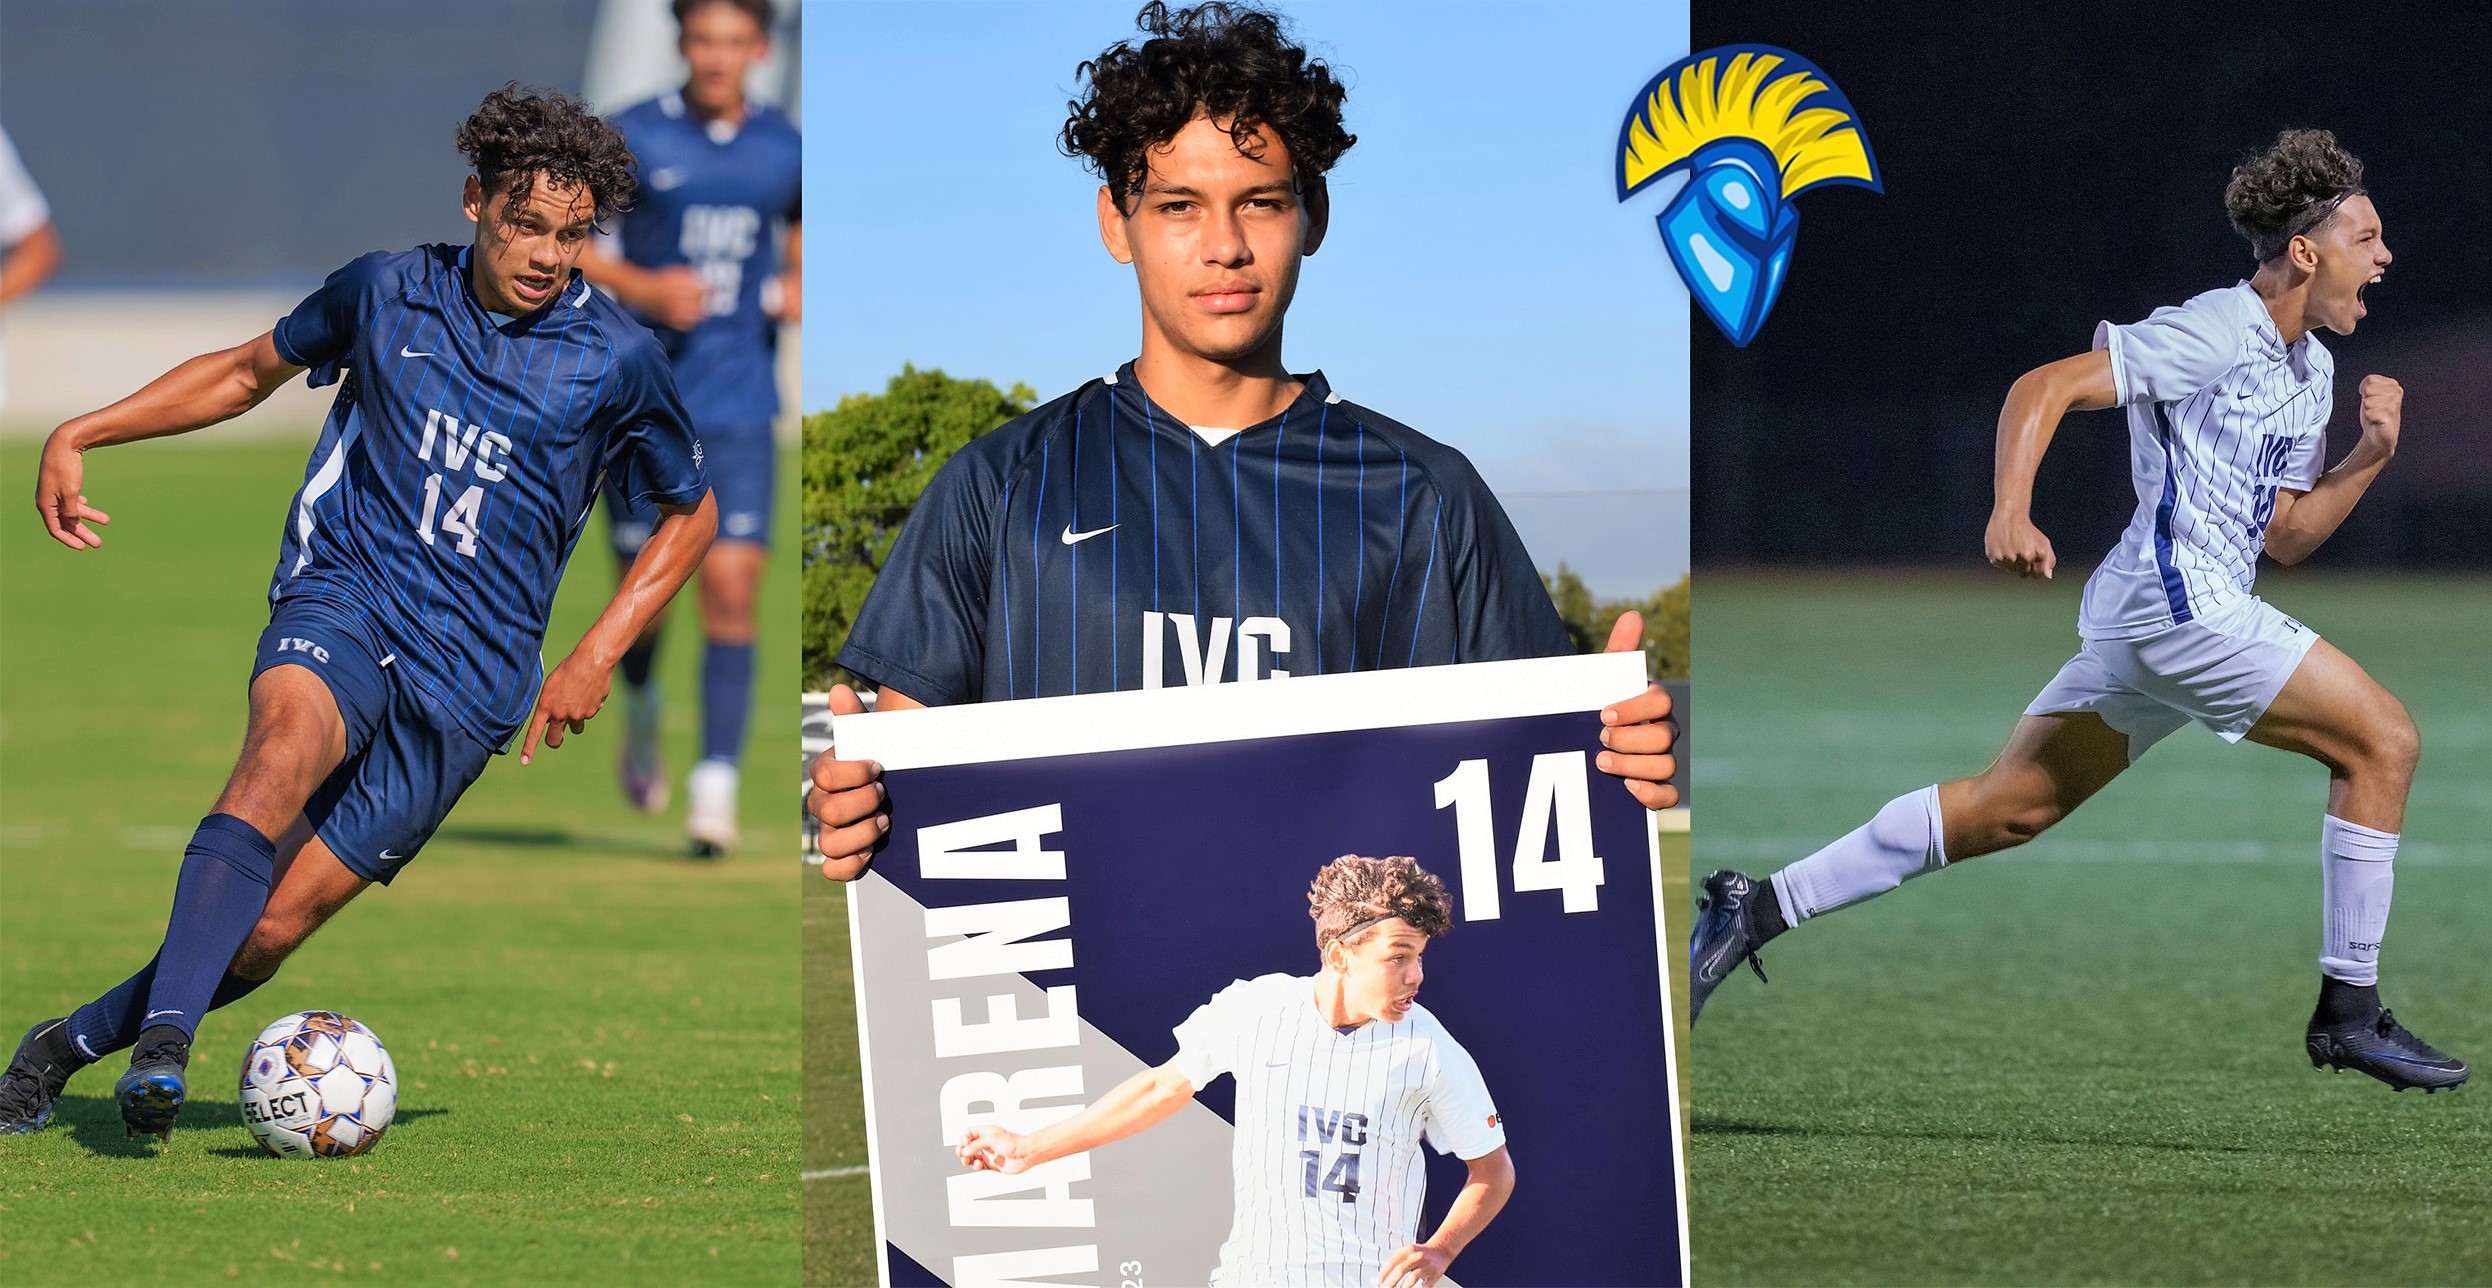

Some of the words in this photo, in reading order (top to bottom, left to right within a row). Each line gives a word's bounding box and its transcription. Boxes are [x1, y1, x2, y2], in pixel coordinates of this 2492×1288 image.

[417, 408, 513, 482] IVC
[416, 472, 485, 558] 14
[277, 637, 330, 664] IVC
[1143, 611, 1290, 690] IVC
[1433, 750, 1605, 922] 14
[1297, 1105, 1368, 1146] IVC
[1299, 1150, 1360, 1203] 14
